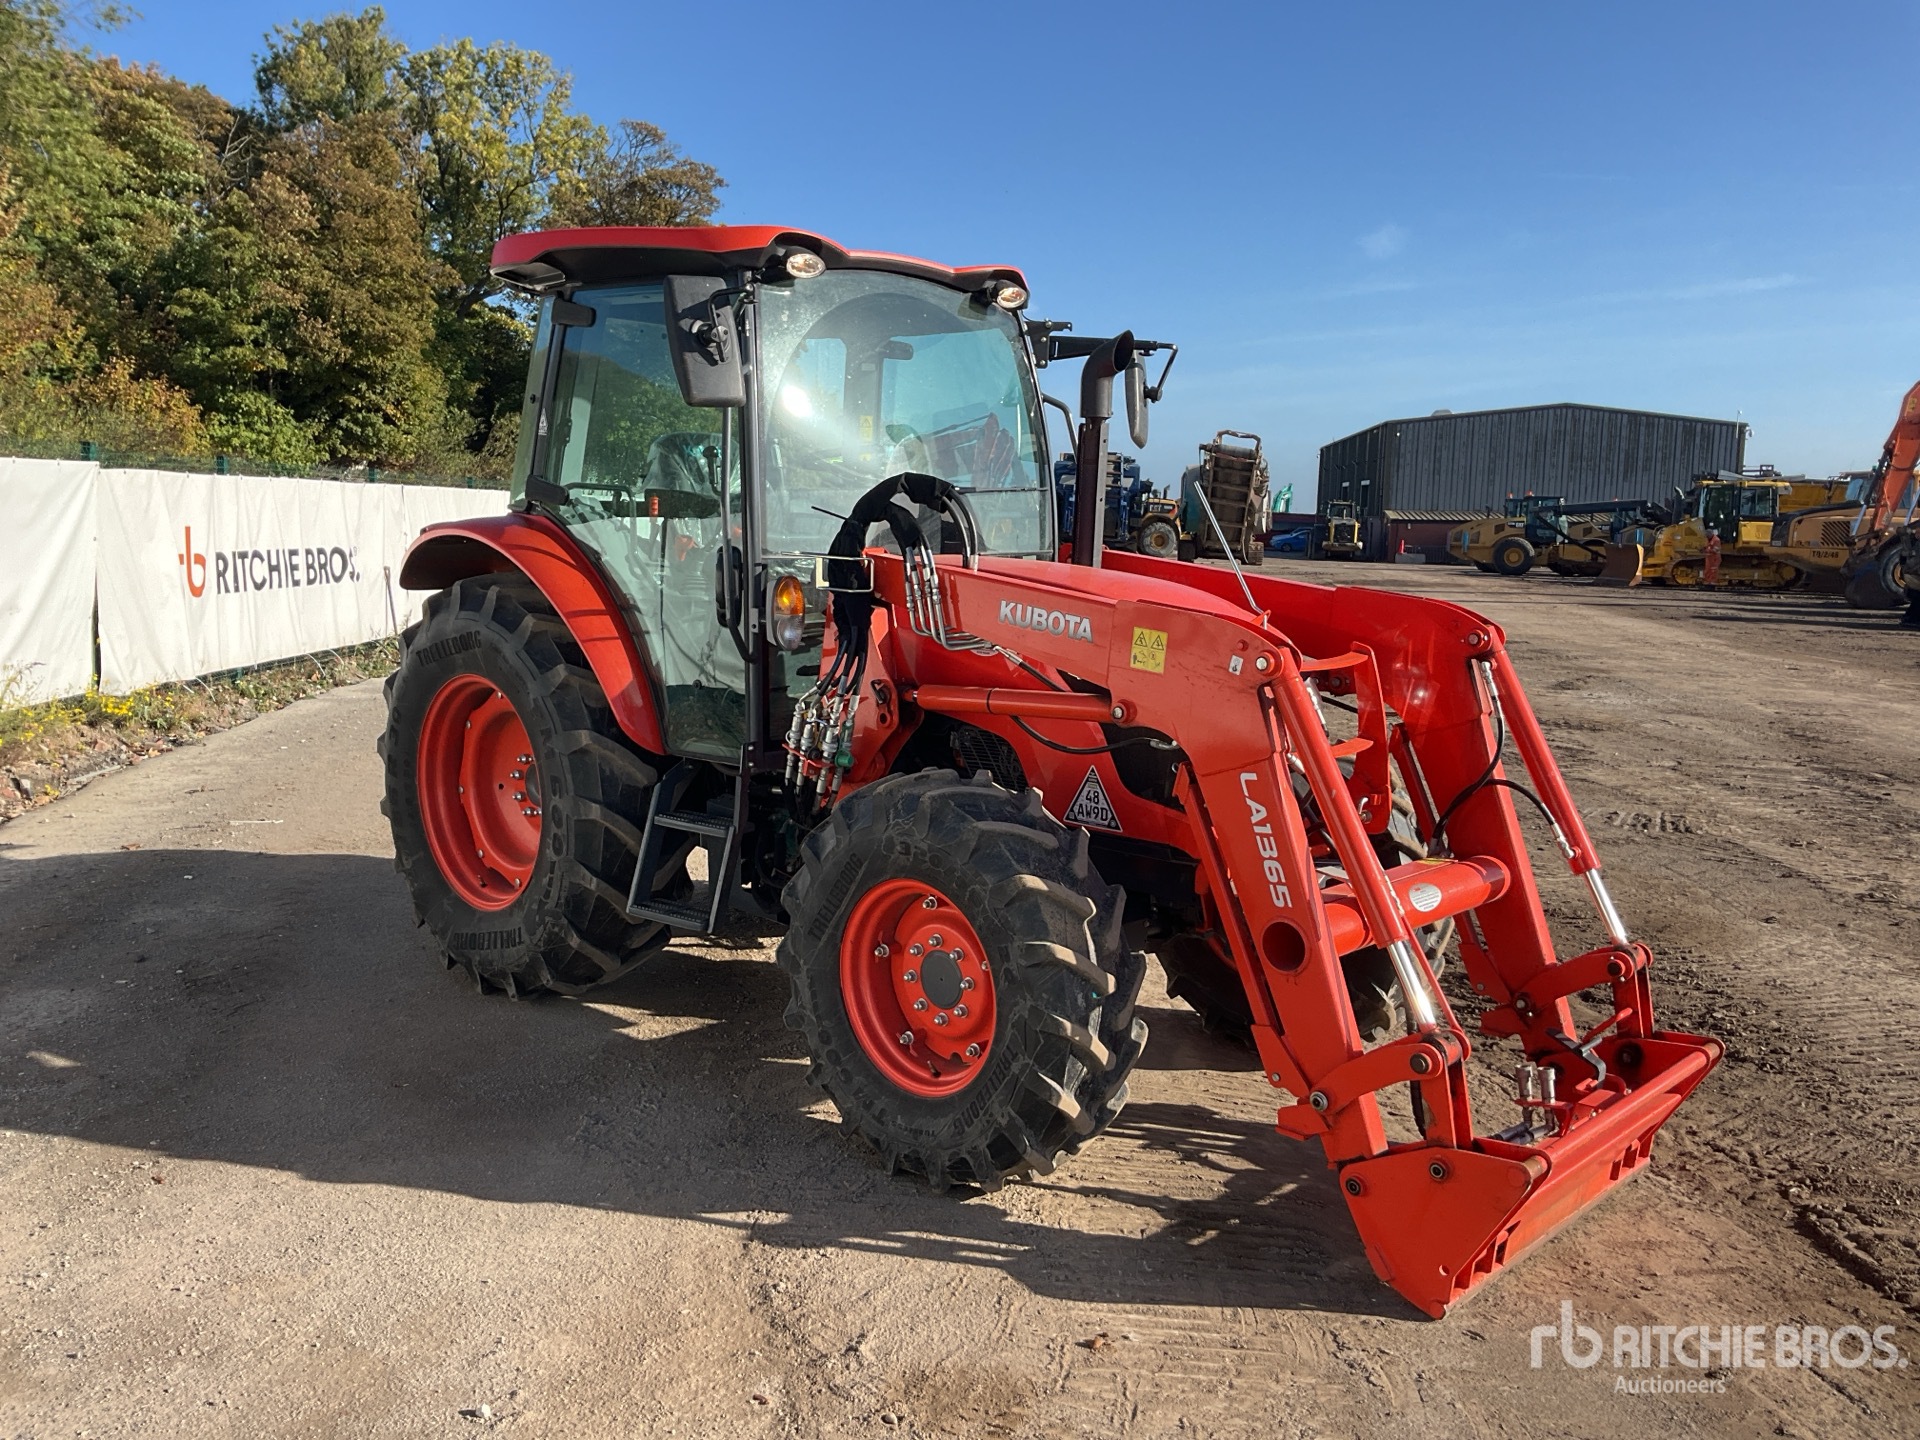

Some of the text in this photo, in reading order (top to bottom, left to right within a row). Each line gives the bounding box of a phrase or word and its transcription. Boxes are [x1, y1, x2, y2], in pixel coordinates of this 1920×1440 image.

[215, 549, 301, 595] RITCHIE
[999, 599, 1093, 643] KUBOTA
[415, 630, 482, 667] TRELLEBORG
[1077, 803, 1109, 822] AW9D
[1085, 789, 1100, 806] 48
[1240, 772, 1293, 909] LA1365
[807, 852, 863, 941] TRELLEBORG
[452, 926, 525, 951] TRELLEBORG
[952, 1045, 1020, 1137] TRELLEBORG
